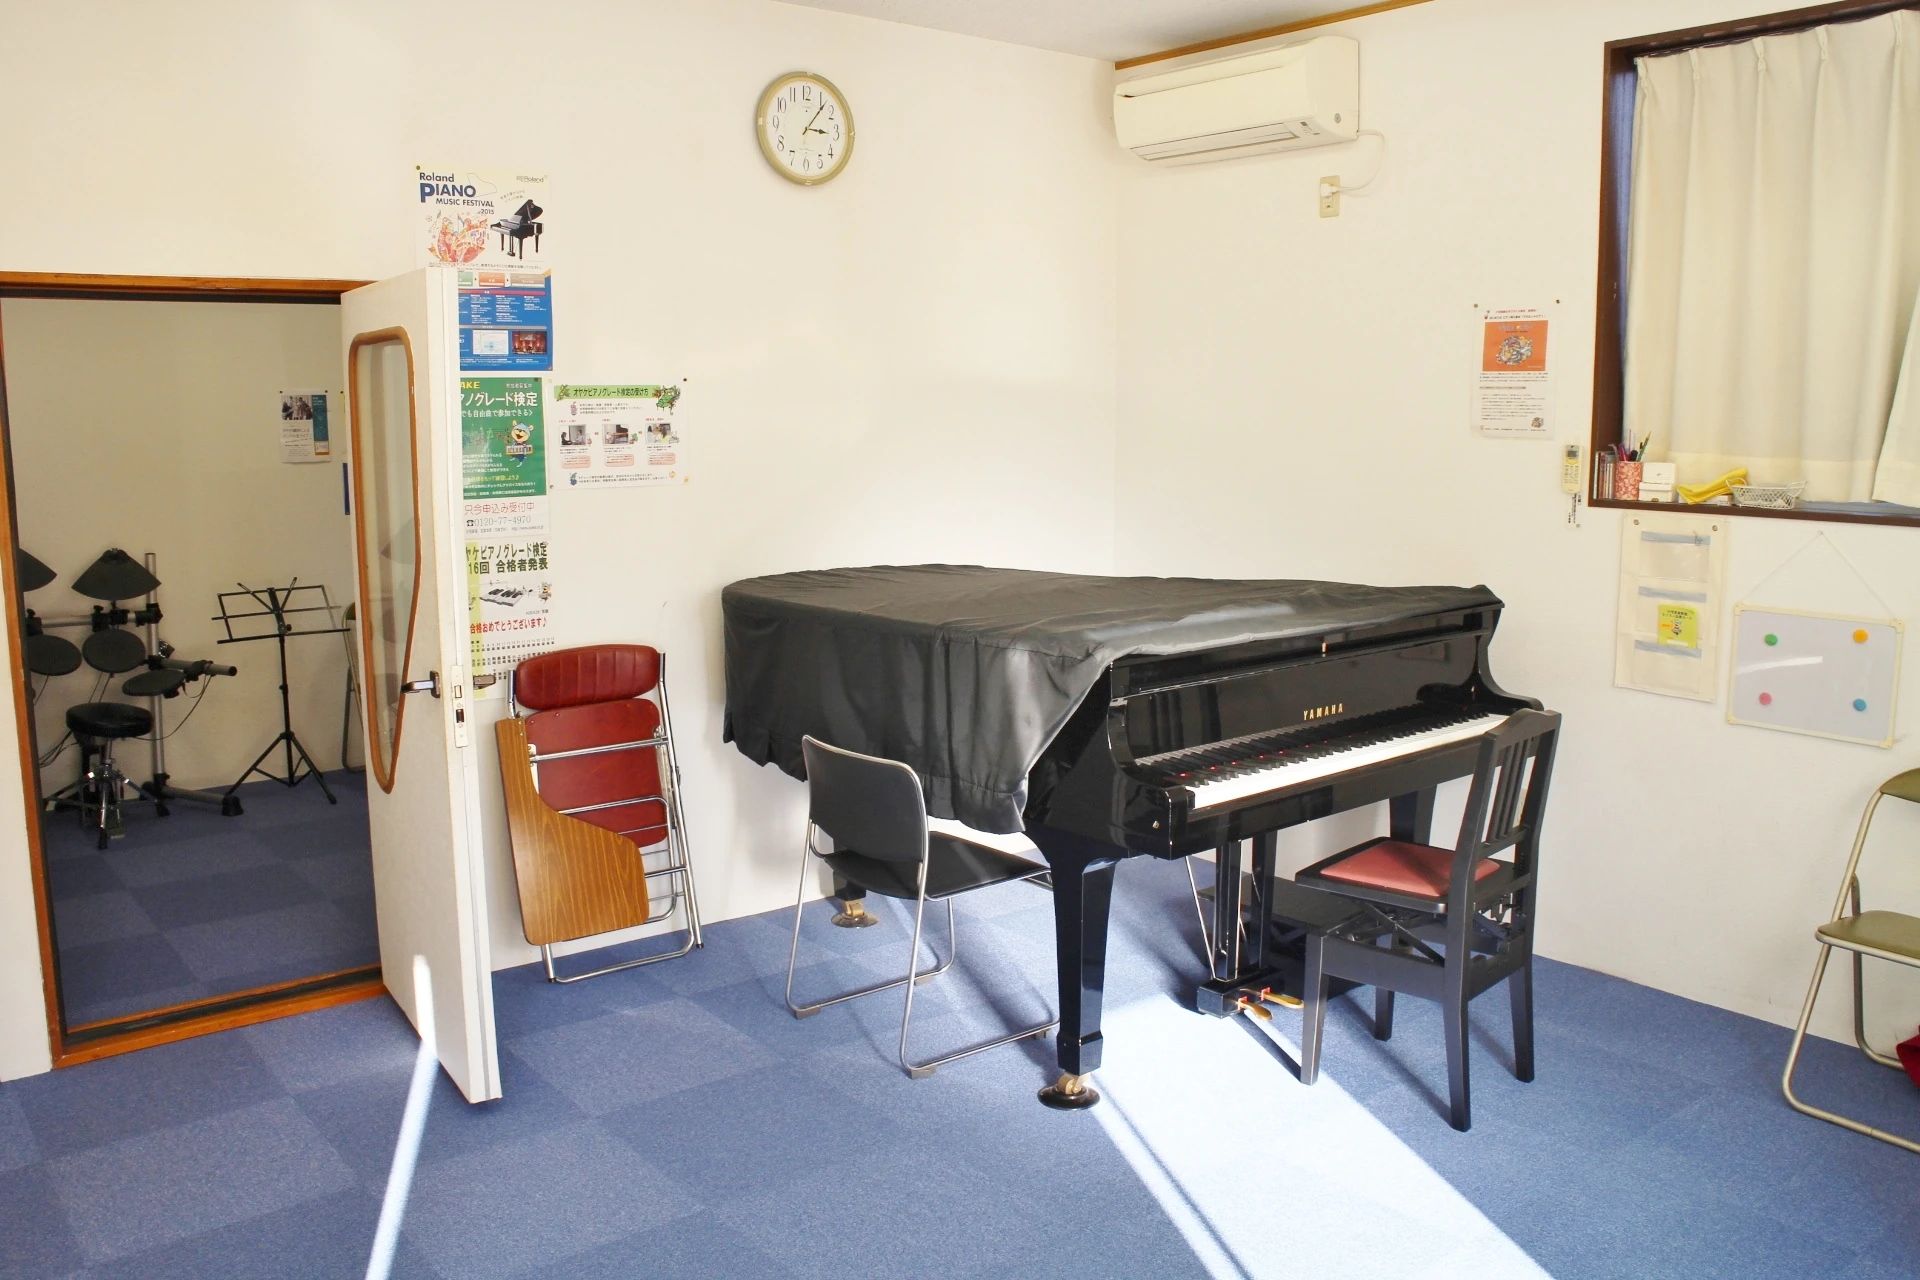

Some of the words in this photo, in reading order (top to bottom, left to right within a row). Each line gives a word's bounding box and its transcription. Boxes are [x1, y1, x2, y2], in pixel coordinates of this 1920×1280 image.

[789, 87, 796, 103] 11
[802, 84, 811, 101] 12
[777, 97, 787, 113] 10
[828, 105, 835, 120] 2
[772, 115, 780, 132] 9
[833, 124, 840, 142] 3
[777, 135, 785, 152] 8
[828, 143, 834, 159] 4
[789, 150, 796, 166] 7
[803, 155, 810, 172] 6
[817, 154, 824, 169] 5
[420, 172, 455, 182] Roland
[420, 183, 476, 203] PIANO
[436, 198, 460, 206] MUSIC
[463, 199, 494, 207] FESTIVAL
[496, 557, 549, 574] 合格者発表
[1303, 703, 1343, 721] YAMAHA
